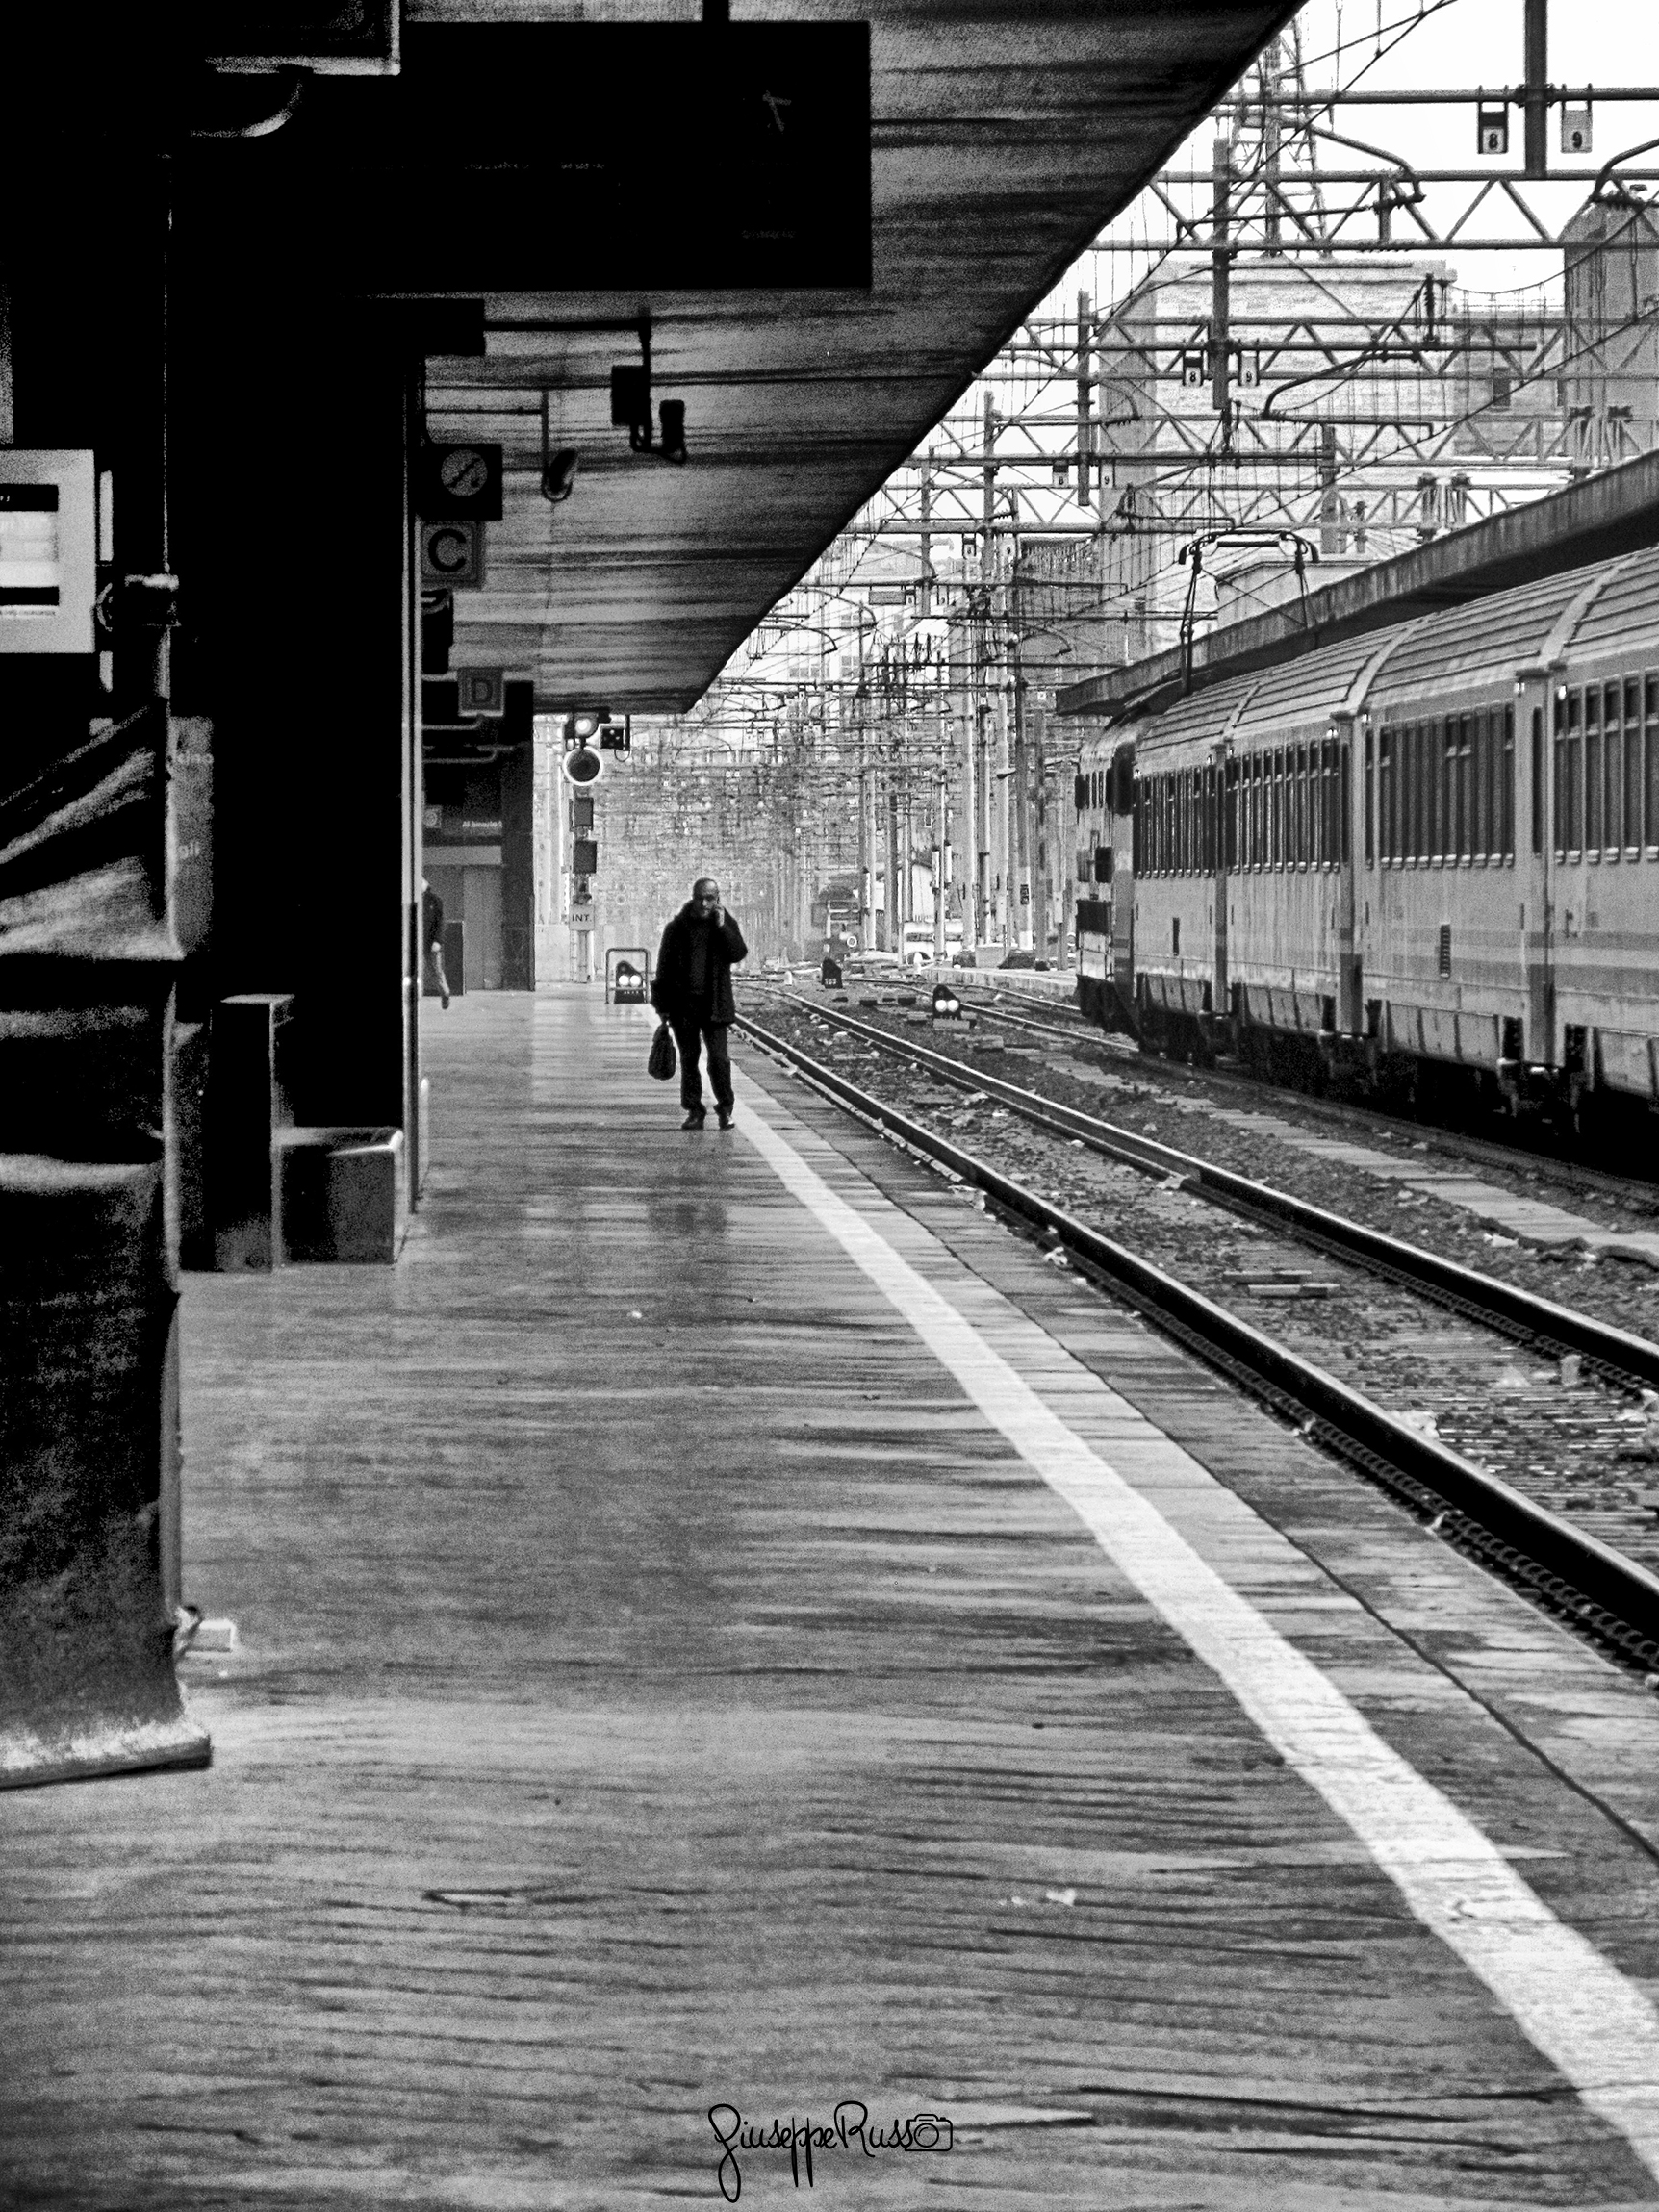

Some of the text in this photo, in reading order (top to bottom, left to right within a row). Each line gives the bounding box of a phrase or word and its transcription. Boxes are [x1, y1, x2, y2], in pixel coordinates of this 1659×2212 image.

[1488, 133, 1498, 150] 8
[1572, 131, 1583, 149] 9
[427, 528, 468, 574] C
[471, 677, 493, 704] D
[571, 913, 593, 923] INT.
